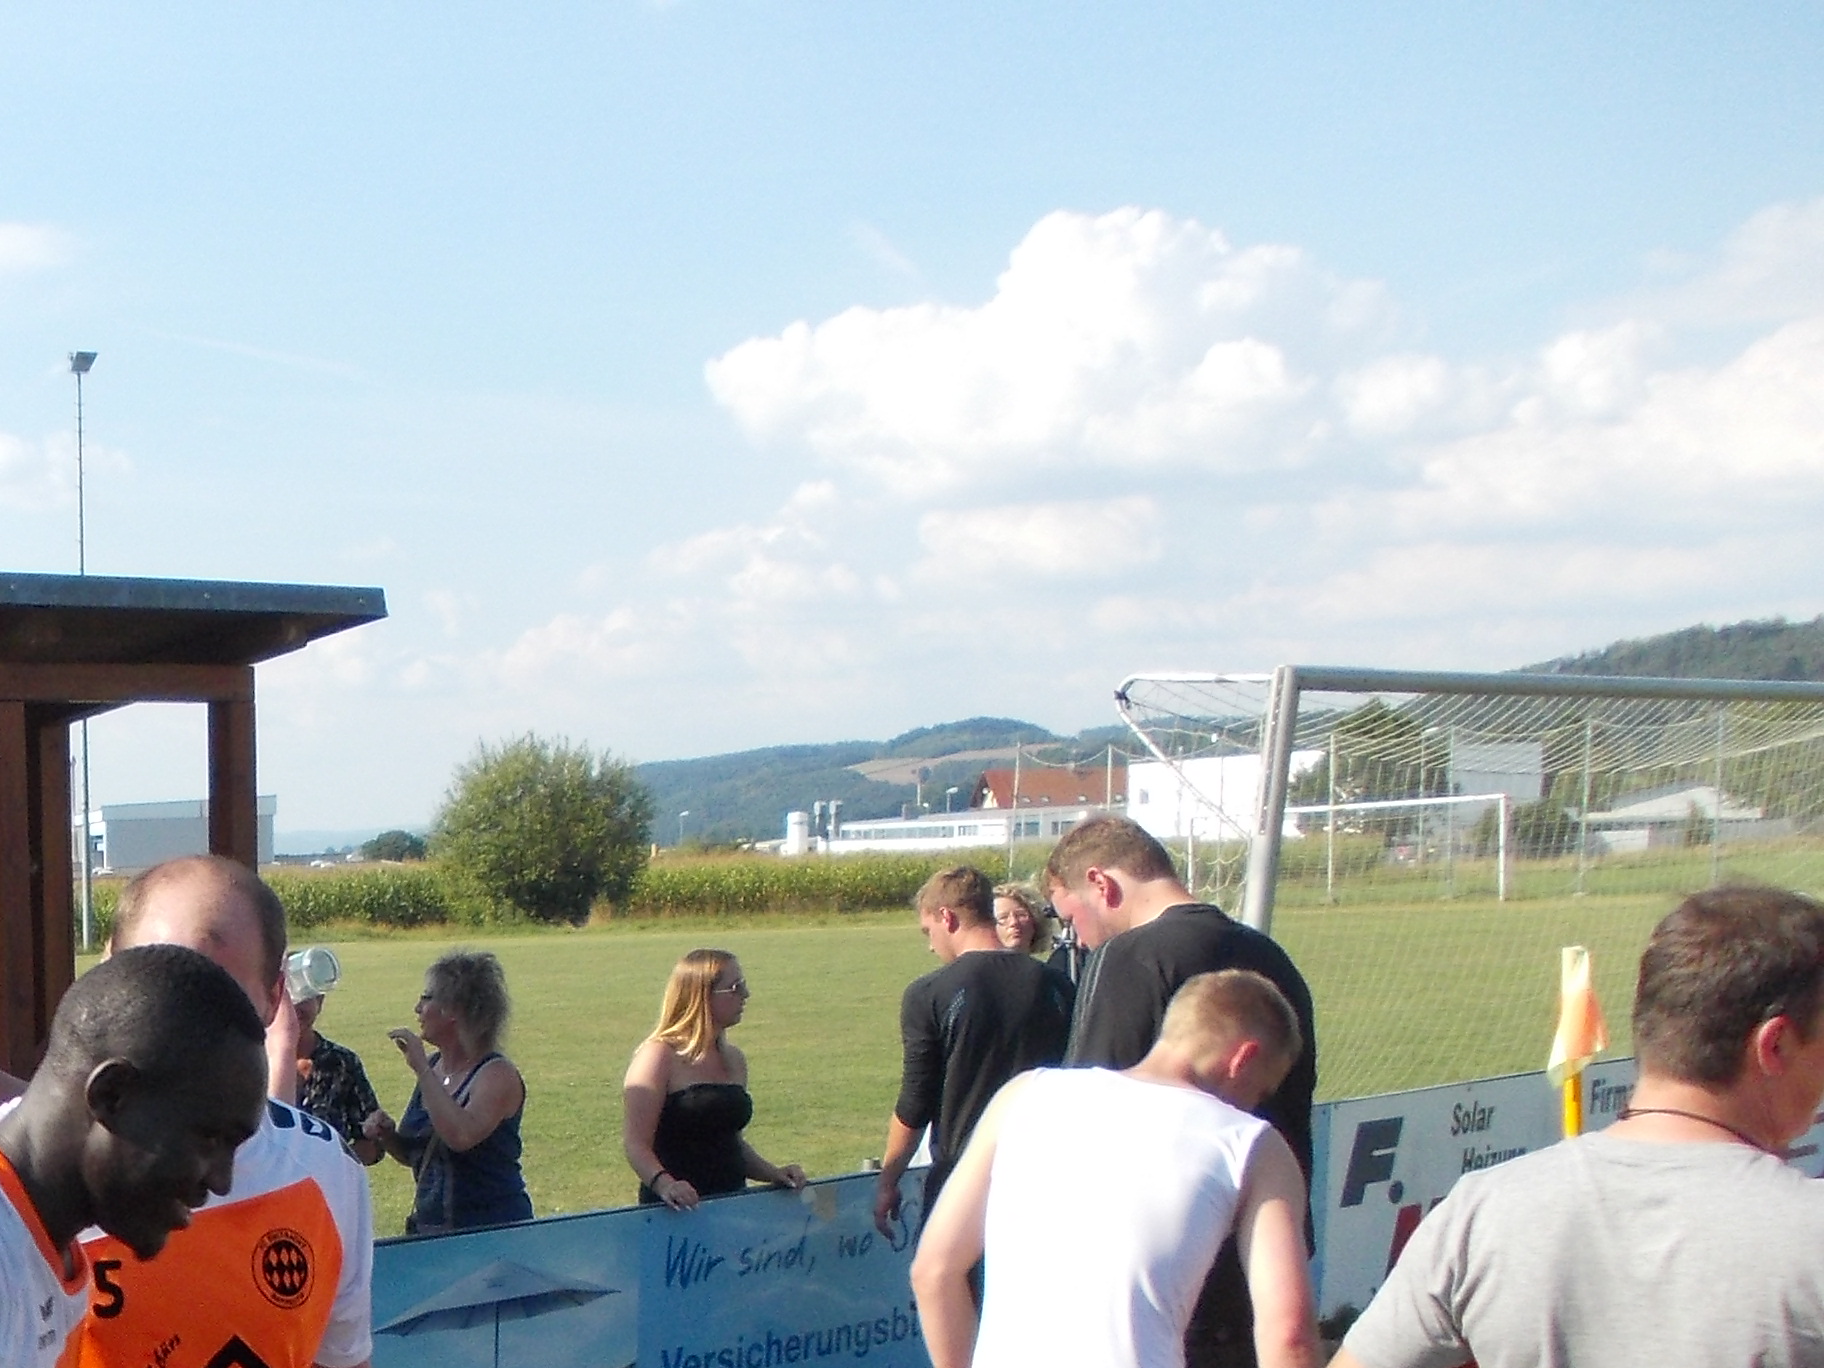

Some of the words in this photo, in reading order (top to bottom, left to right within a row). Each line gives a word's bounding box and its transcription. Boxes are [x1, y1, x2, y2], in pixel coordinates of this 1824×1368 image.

[1589, 1078, 1634, 1115] Firm
[1450, 1100, 1495, 1137] Solar
[665, 1236, 725, 1290] Wir
[739, 1214, 816, 1276] sind,
[838, 1233, 874, 1258] wo
